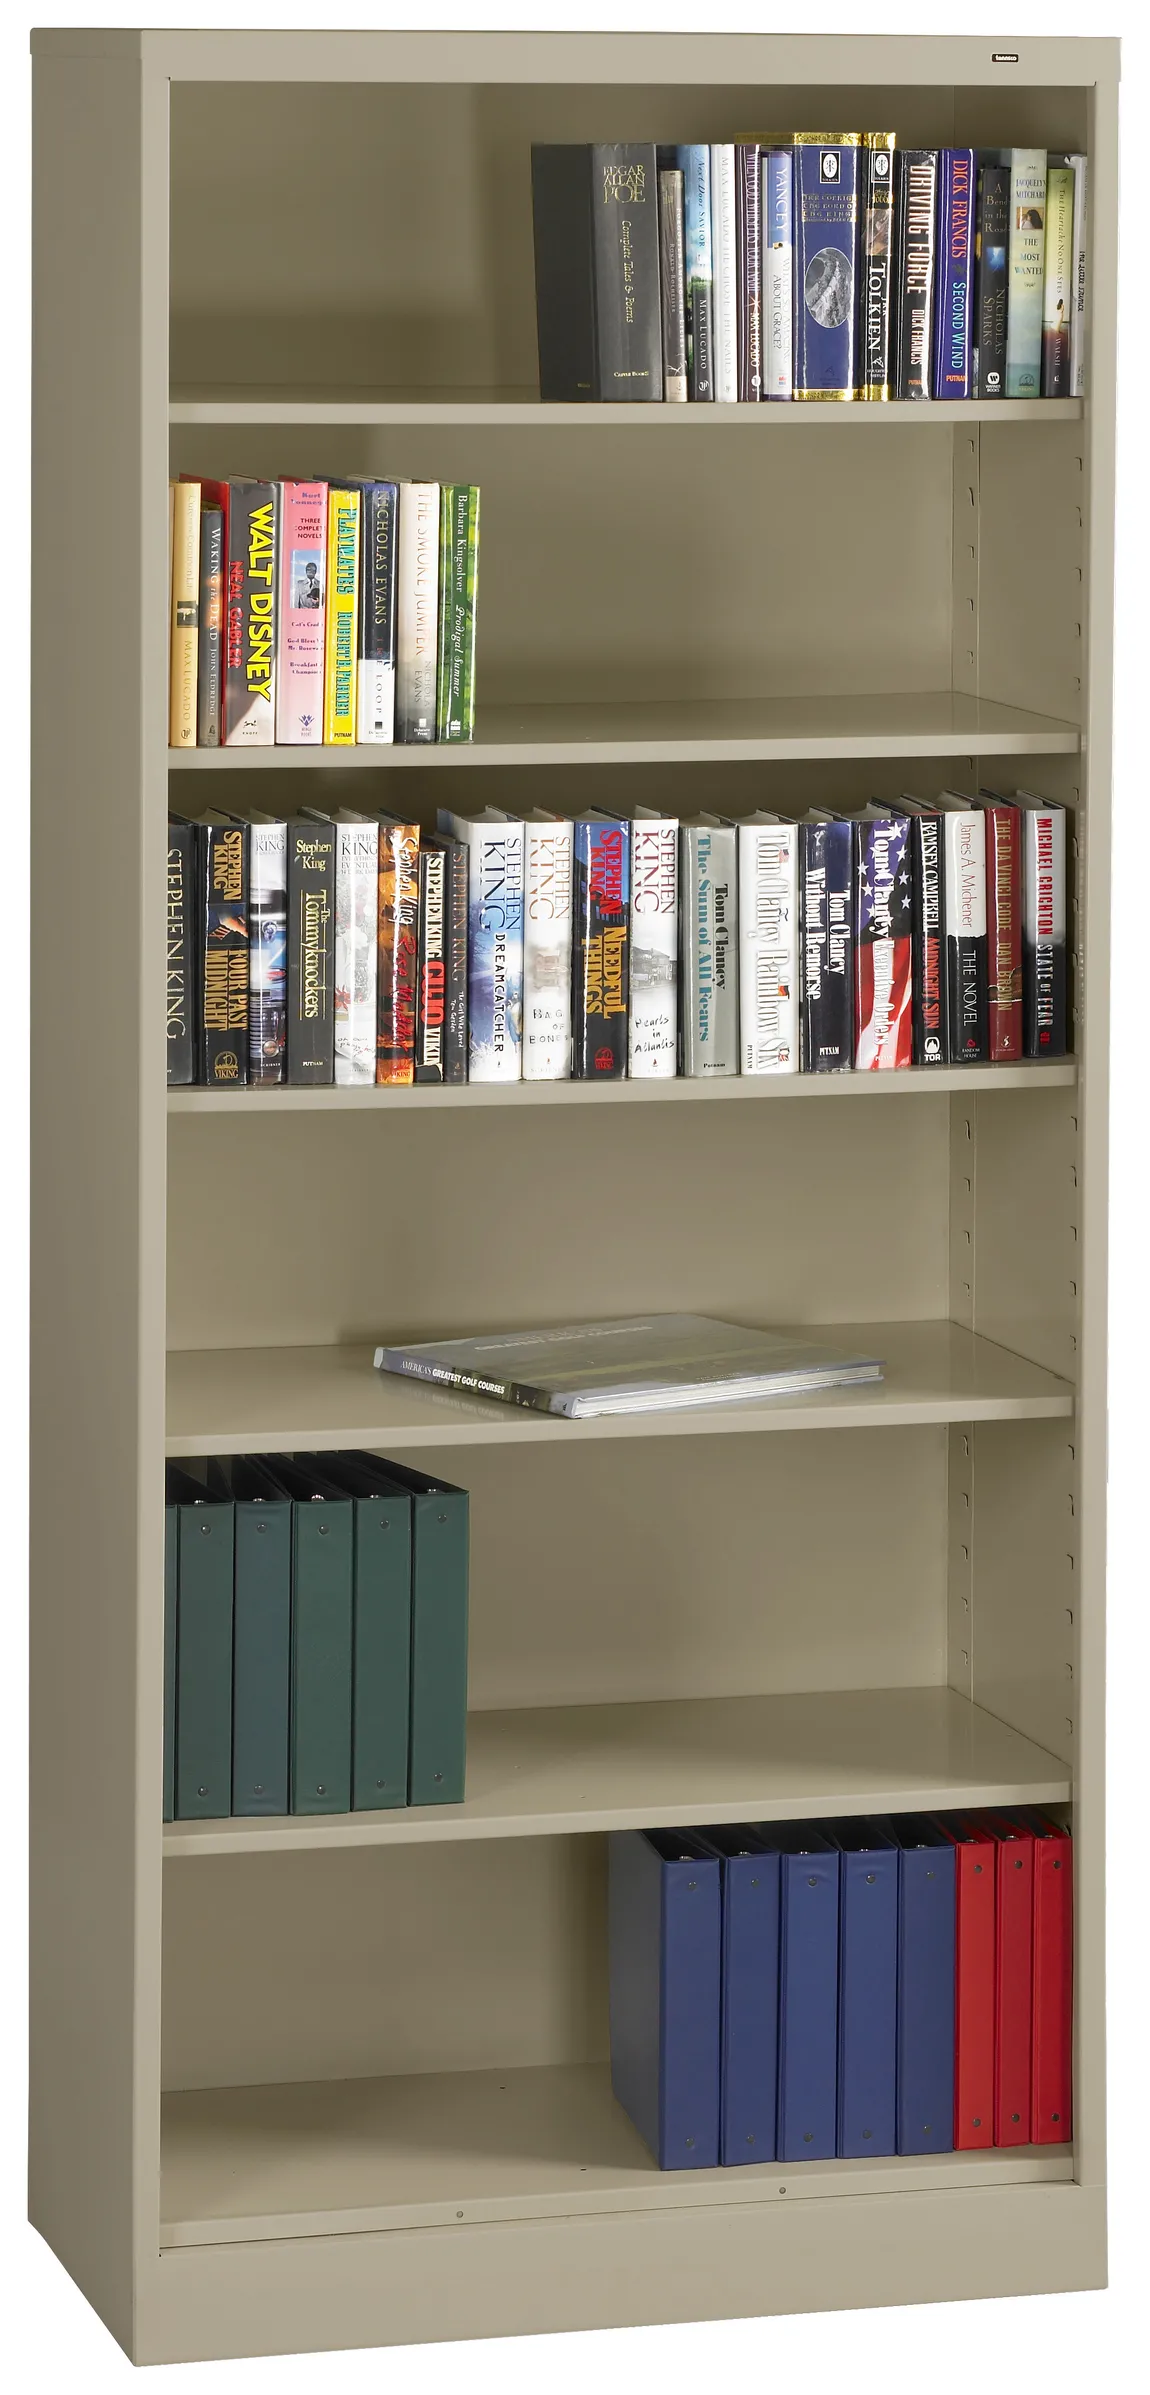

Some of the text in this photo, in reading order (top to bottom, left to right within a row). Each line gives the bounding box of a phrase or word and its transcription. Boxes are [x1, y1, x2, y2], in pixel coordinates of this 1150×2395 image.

[603, 165, 645, 176] EDGAR
[603, 174, 645, 187] ALLAN
[603, 186, 646, 204] POE
[698, 184, 706, 207] Door
[775, 167, 789, 232] YANCEY
[994, 183, 1002, 193] A
[620, 220, 632, 258] Complete
[698, 211, 707, 247] SAVIOR
[906, 165, 935, 294] DRIVING FORCE
[951, 159, 968, 259] DICK FRANCIS
[1024, 238, 1038, 246] THE
[1058, 207, 1066, 244] Heartache
[623, 261, 634, 282] Tales
[1020, 253, 1040, 262] MOST
[626, 297, 635, 323] Poems
[699, 299, 707, 369] MAX LUCADO
[773, 274, 783, 350] ABOUT GRACE?
[868, 262, 887, 351] TOLKIEN
[910, 308, 925, 365] DICK FRANCIS
[951, 281, 967, 369] SECOND WIND
[983, 296, 994, 347] SPARKS
[996, 288, 1006, 355] NICHOLAS
[210, 527, 221, 584] WAKING
[336, 508, 357, 595] PLAYMATES
[375, 490, 389, 625] NICHOLAS EVANS
[452, 494, 468, 592] Barbara Kingsolver
[208, 604, 220, 641] DEAD
[227, 560, 244, 668] NEAL GABLER
[246, 501, 273, 703] WALT DISNEY
[337, 611, 353, 659] ROBERT
[183, 640, 192, 721] MAX LUCADO
[208, 648, 217, 717] JOHN ELDREDGE
[414, 670, 423, 703] EVANS
[451, 604, 466, 697] Prodigal Summer
[336, 670, 350, 717] PARKER
[213, 844, 228, 891] KING
[223, 830, 242, 900] STEPHEN
[256, 840, 285, 852] KING
[296, 839, 332, 856] Stephen
[302, 855, 326, 872] King
[341, 842, 377, 856] KING
[387, 836, 418, 926] Stephen King
[528, 836, 555, 920] KING
[554, 836, 571, 919] STEPHEN
[589, 846, 604, 901] KING
[599, 829, 623, 915] STEPHEN
[634, 830, 660, 914] KING
[660, 829, 676, 914] STEPHEN
[960, 822, 978, 927] James A. Michener
[1037, 818, 1053, 935] MICHAEL CRICHTON
[320, 907, 332, 925] The
[425, 857, 443, 958] STEPHEN KING
[453, 853, 467, 930] STEPHEN
[478, 840, 506, 932] KING
[506, 838, 521, 931] STEPHEN
[996, 819, 1013, 1012] THE DA VINCI CODE DAN BROWN
[167, 848, 185, 1040] STEPHEN KING
[300, 889, 327, 1019] Tommyknockers
[451, 937, 466, 982] KING
[696, 834, 712, 1042] The Sum of All Fears
[711, 883, 729, 991] Tom Clancy
[748, 832, 790, 1070] Tom Clancy Rainbow Six
[804, 867, 826, 1000] Without Remorse
[823, 889, 851, 976] Tom Clancy
[869, 826, 895, 1046] Tom Clancy Executive Orders
[921, 820, 941, 1029] RAMSEY CAMPBELL MIDNIGHT SUN
[204, 949, 229, 1032] MIDNIGHT
[228, 949, 248, 1031] FOUR PAST
[421, 961, 445, 1025] CUJO
[494, 933, 506, 1053] DREAMCATCHER
[581, 934, 604, 1014] THINGS
[603, 926, 627, 1020] NEEDFUL
[962, 950, 978, 1027] THE NOVEL
[1037, 944, 1054, 1027] STATE OF FEAR
[533, 1008, 564, 1019] BAG
[634, 1013, 670, 1029] Hearts
[634, 1038, 676, 1054] Atlantis
[652, 1028, 661, 1038] in
[214, 1068, 239, 1079] VIKING
[923, 1054, 941, 1062] TOR
[400, 1360, 506, 1395] AMERICA'S GREATEST GOLF COURSES
